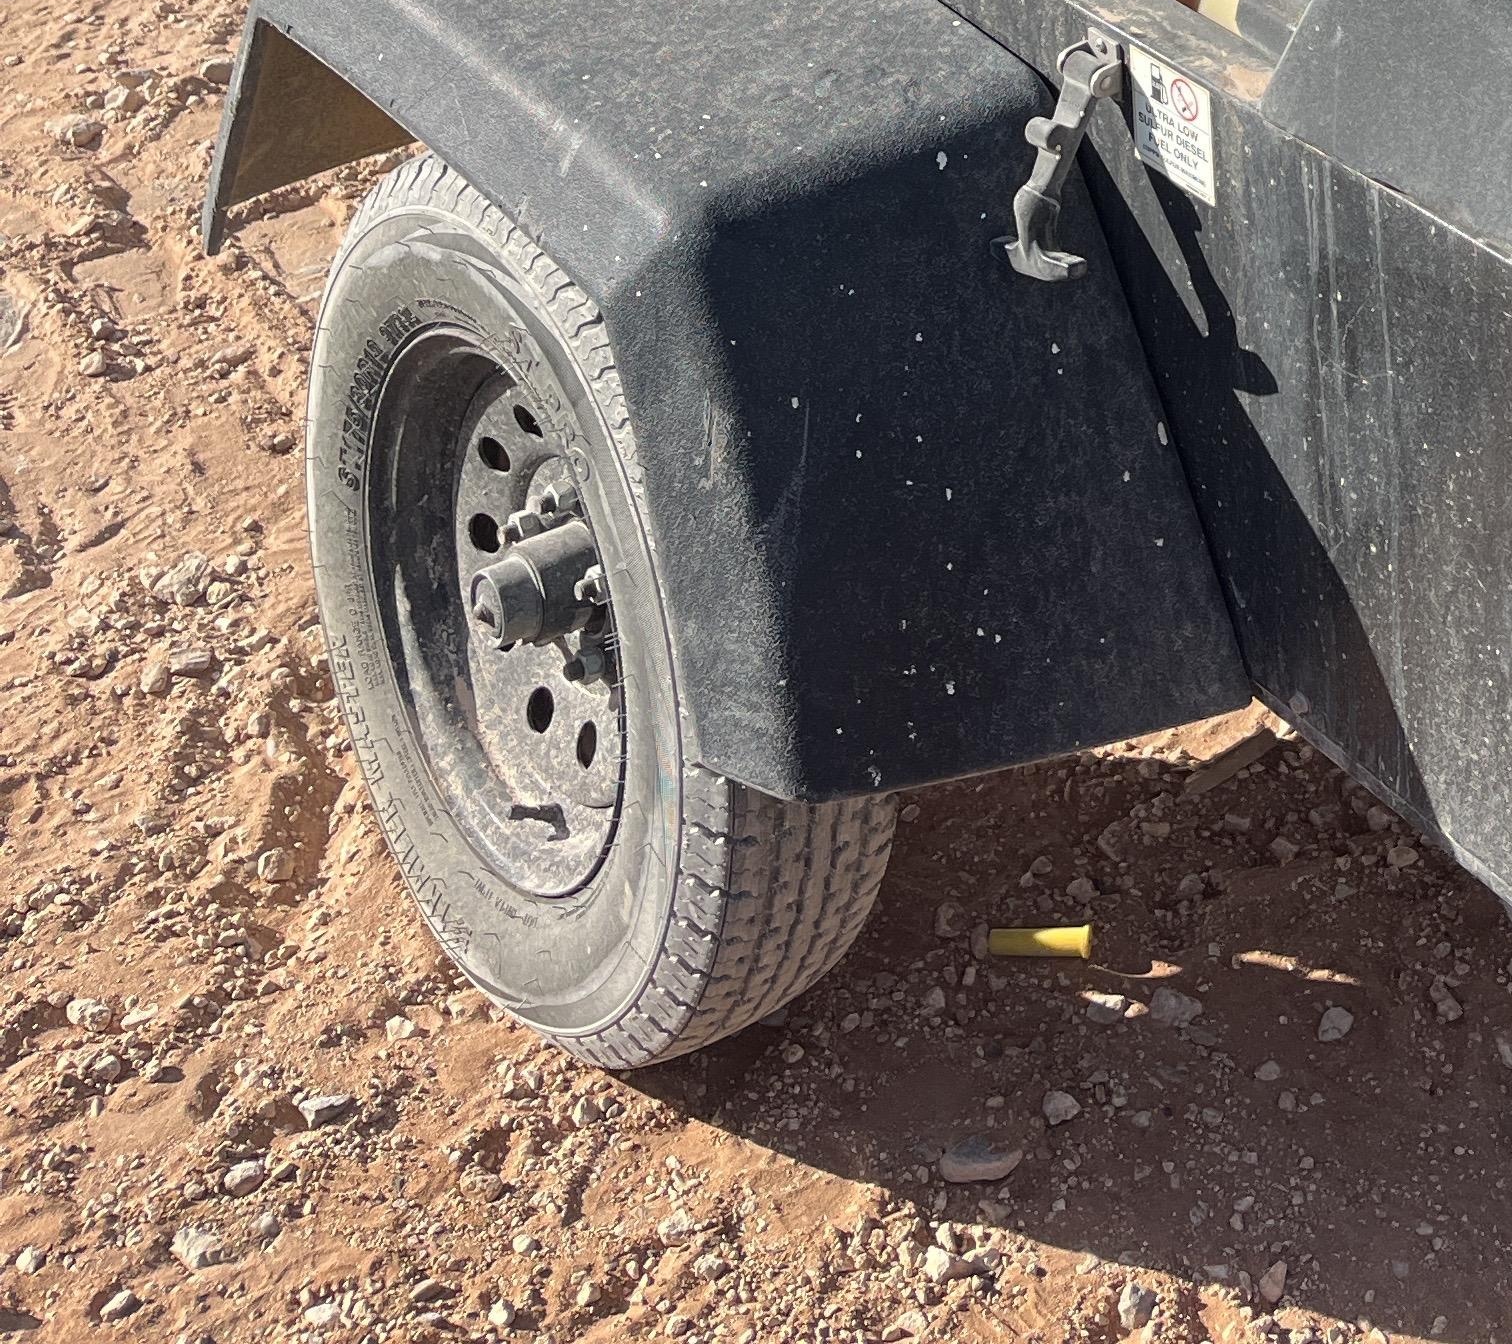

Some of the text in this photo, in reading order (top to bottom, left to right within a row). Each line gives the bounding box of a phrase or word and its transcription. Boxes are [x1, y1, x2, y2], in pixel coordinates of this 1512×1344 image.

[1138, 111, 1209, 163] SULFUR DIESEL
[1145, 101, 1199, 143] ULTRA LOW
[1148, 132, 1199, 171] FUEL ONLY
